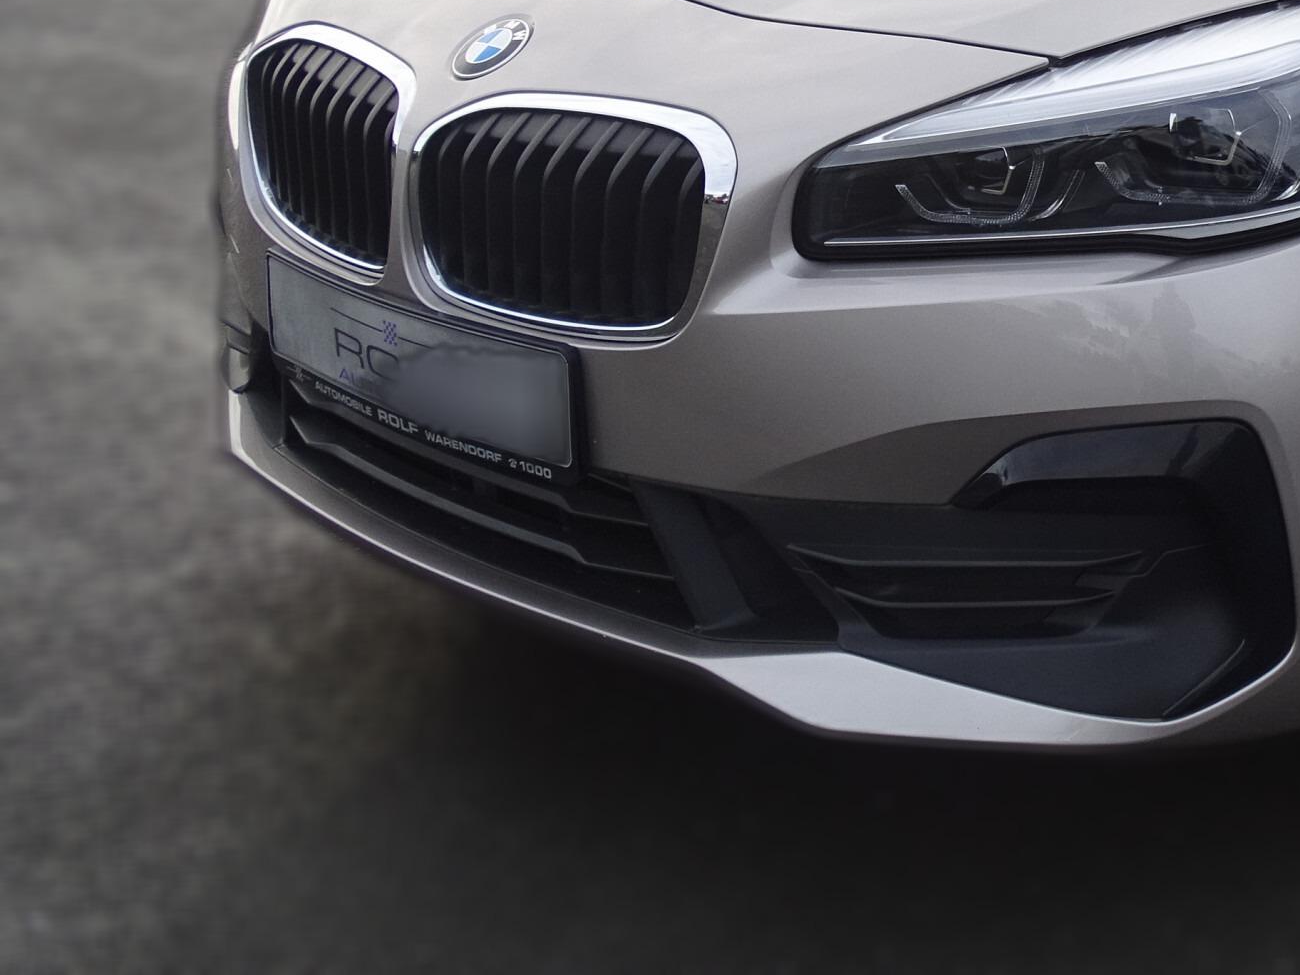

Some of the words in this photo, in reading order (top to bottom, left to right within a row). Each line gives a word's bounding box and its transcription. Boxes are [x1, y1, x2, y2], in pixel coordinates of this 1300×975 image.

[315, 381, 373, 417] AUTOMOBILE
[377, 408, 419, 434] ROLF
[424, 429, 502, 463] WARENDORF
